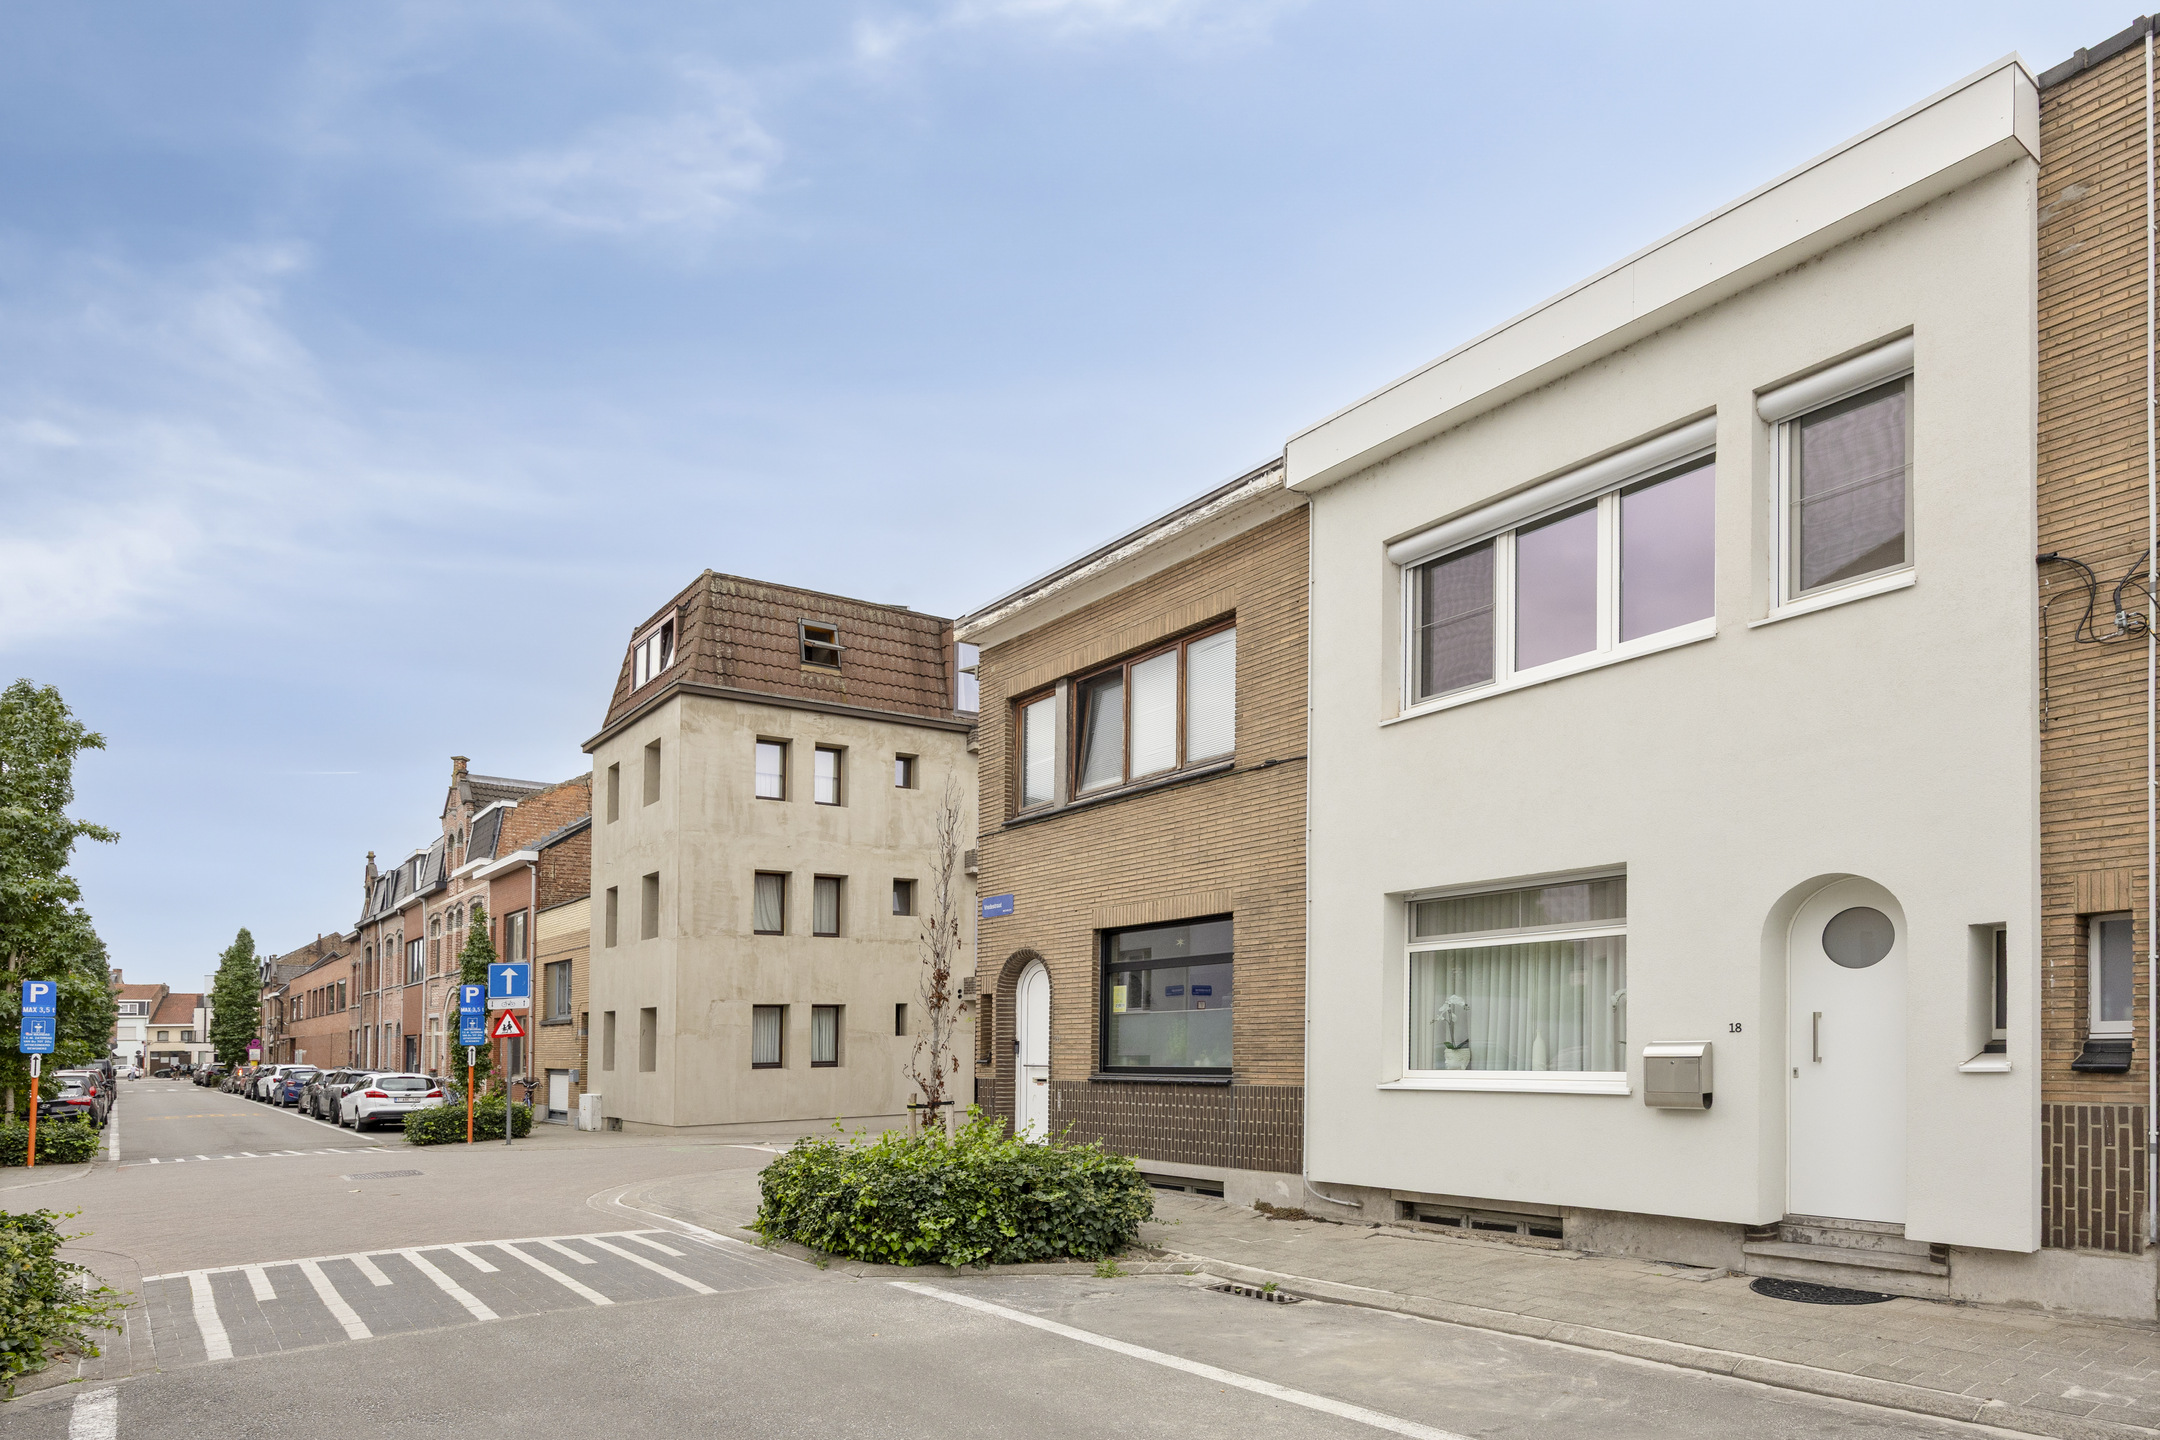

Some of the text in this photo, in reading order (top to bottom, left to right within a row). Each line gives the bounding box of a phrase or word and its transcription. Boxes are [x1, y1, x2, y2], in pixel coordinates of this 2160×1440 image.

[30, 983, 49, 1003] P
[465, 986, 480, 1003] P
[1728, 1022, 1742, 1033] 18
